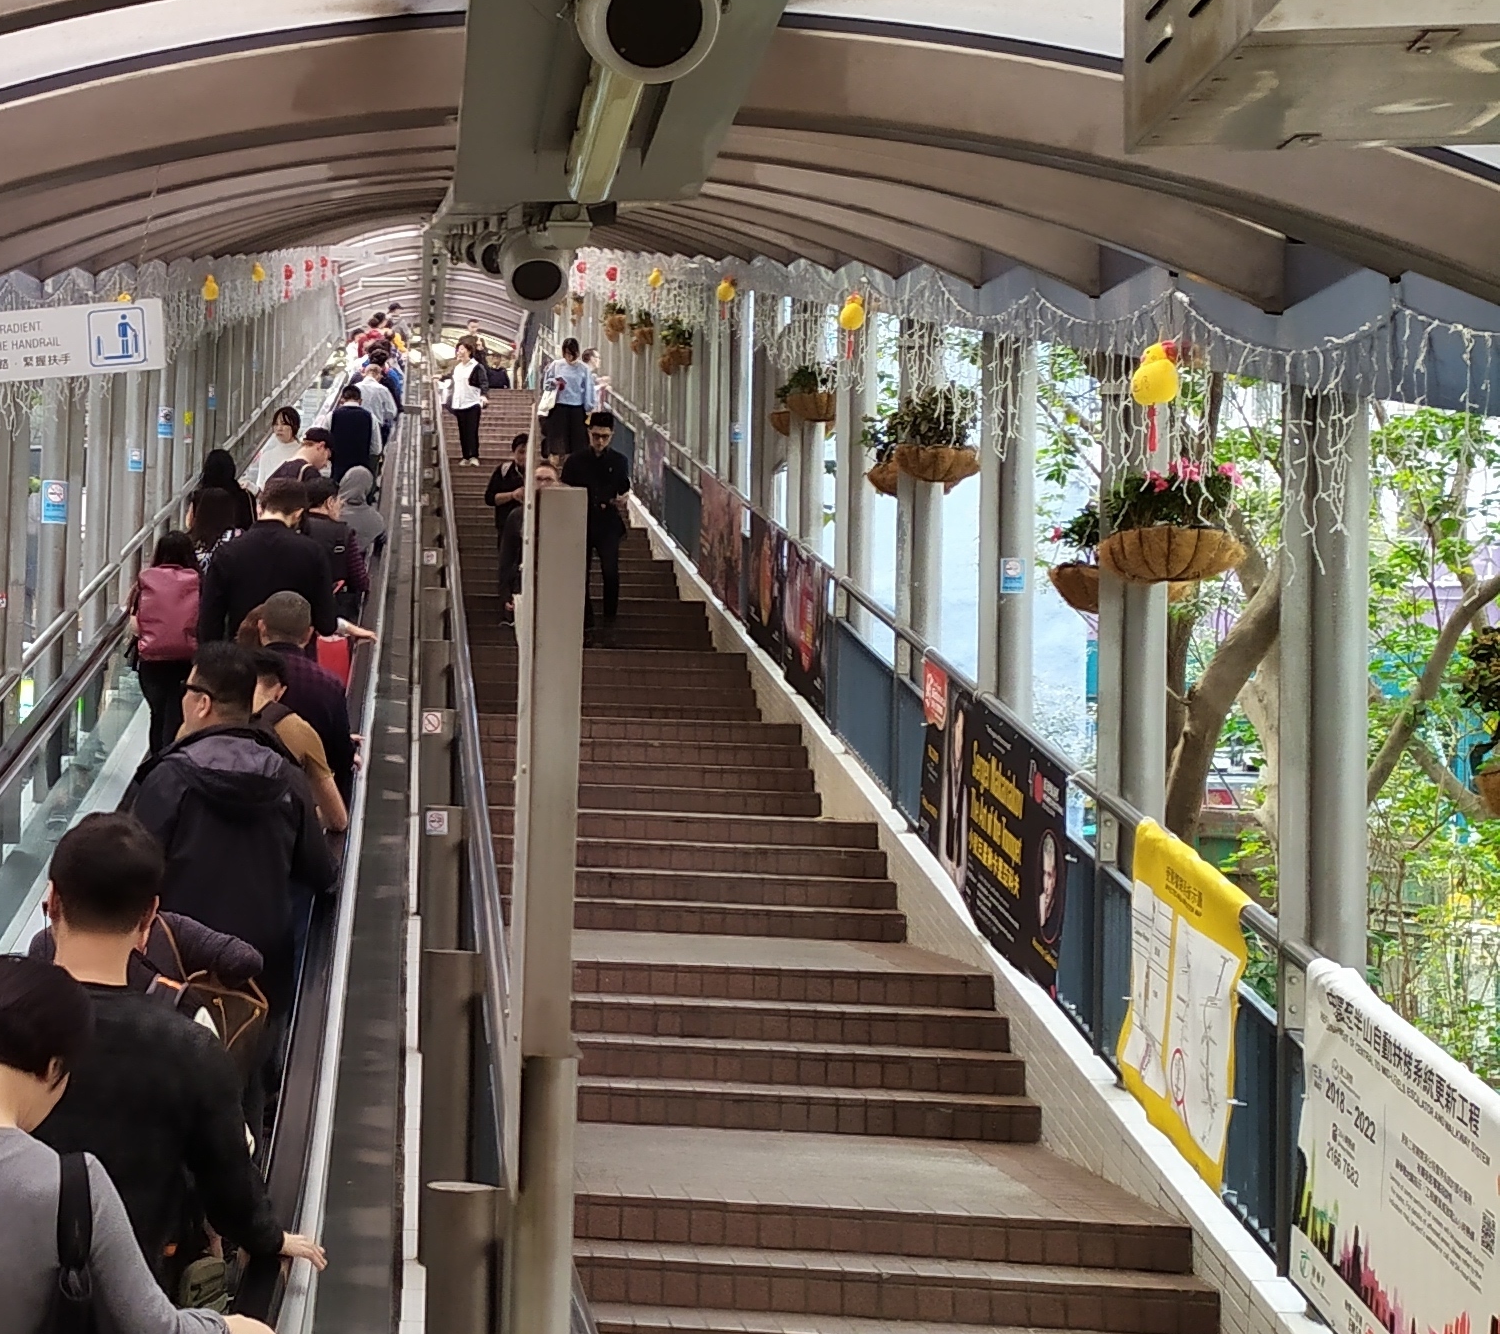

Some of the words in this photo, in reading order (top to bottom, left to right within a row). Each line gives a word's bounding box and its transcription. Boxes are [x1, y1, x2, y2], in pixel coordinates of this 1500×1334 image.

[11, 336, 61, 351] HANDRAIL
[1325, 1077, 1346, 1114] 2018
[1353, 1105, 1376, 1145] 2022
